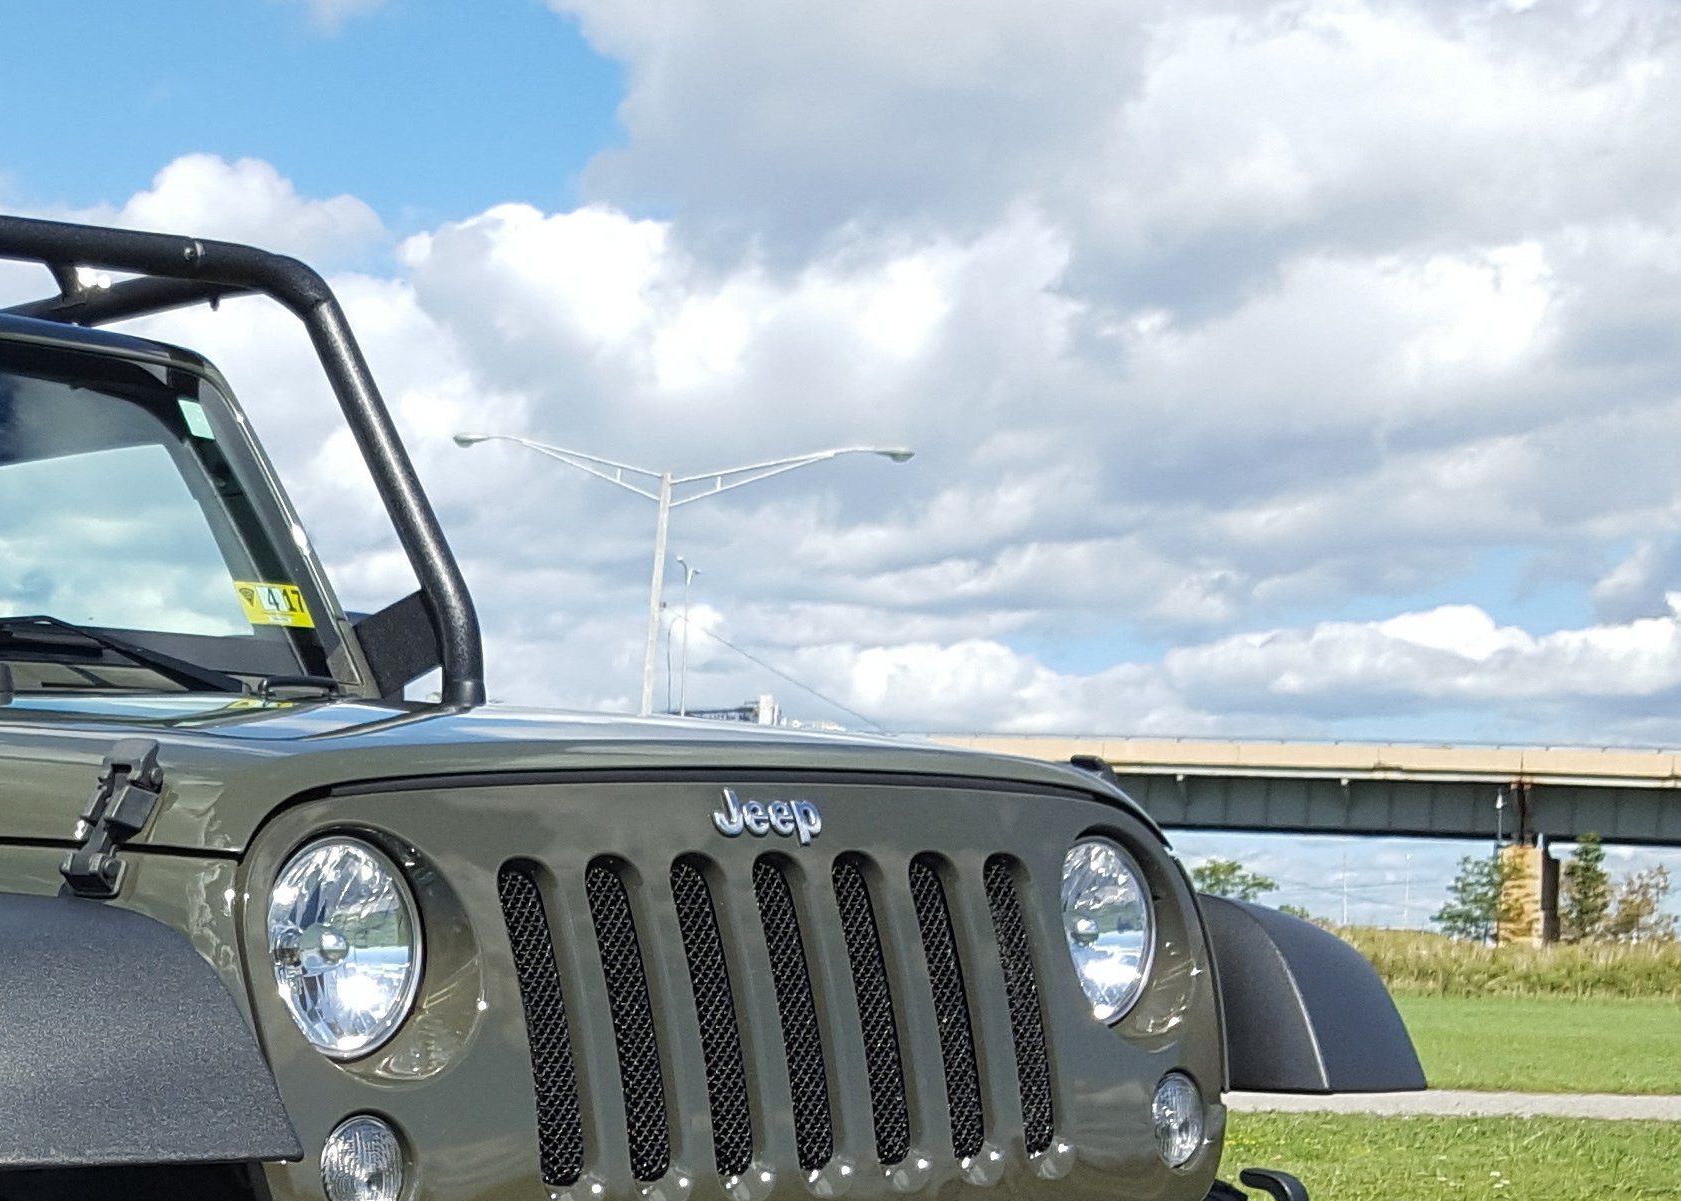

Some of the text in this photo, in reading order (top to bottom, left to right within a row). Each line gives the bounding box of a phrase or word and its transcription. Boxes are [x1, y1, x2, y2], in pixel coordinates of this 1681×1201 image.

[267, 588, 305, 613] 4 17
[712, 786, 823, 847] Jeep
